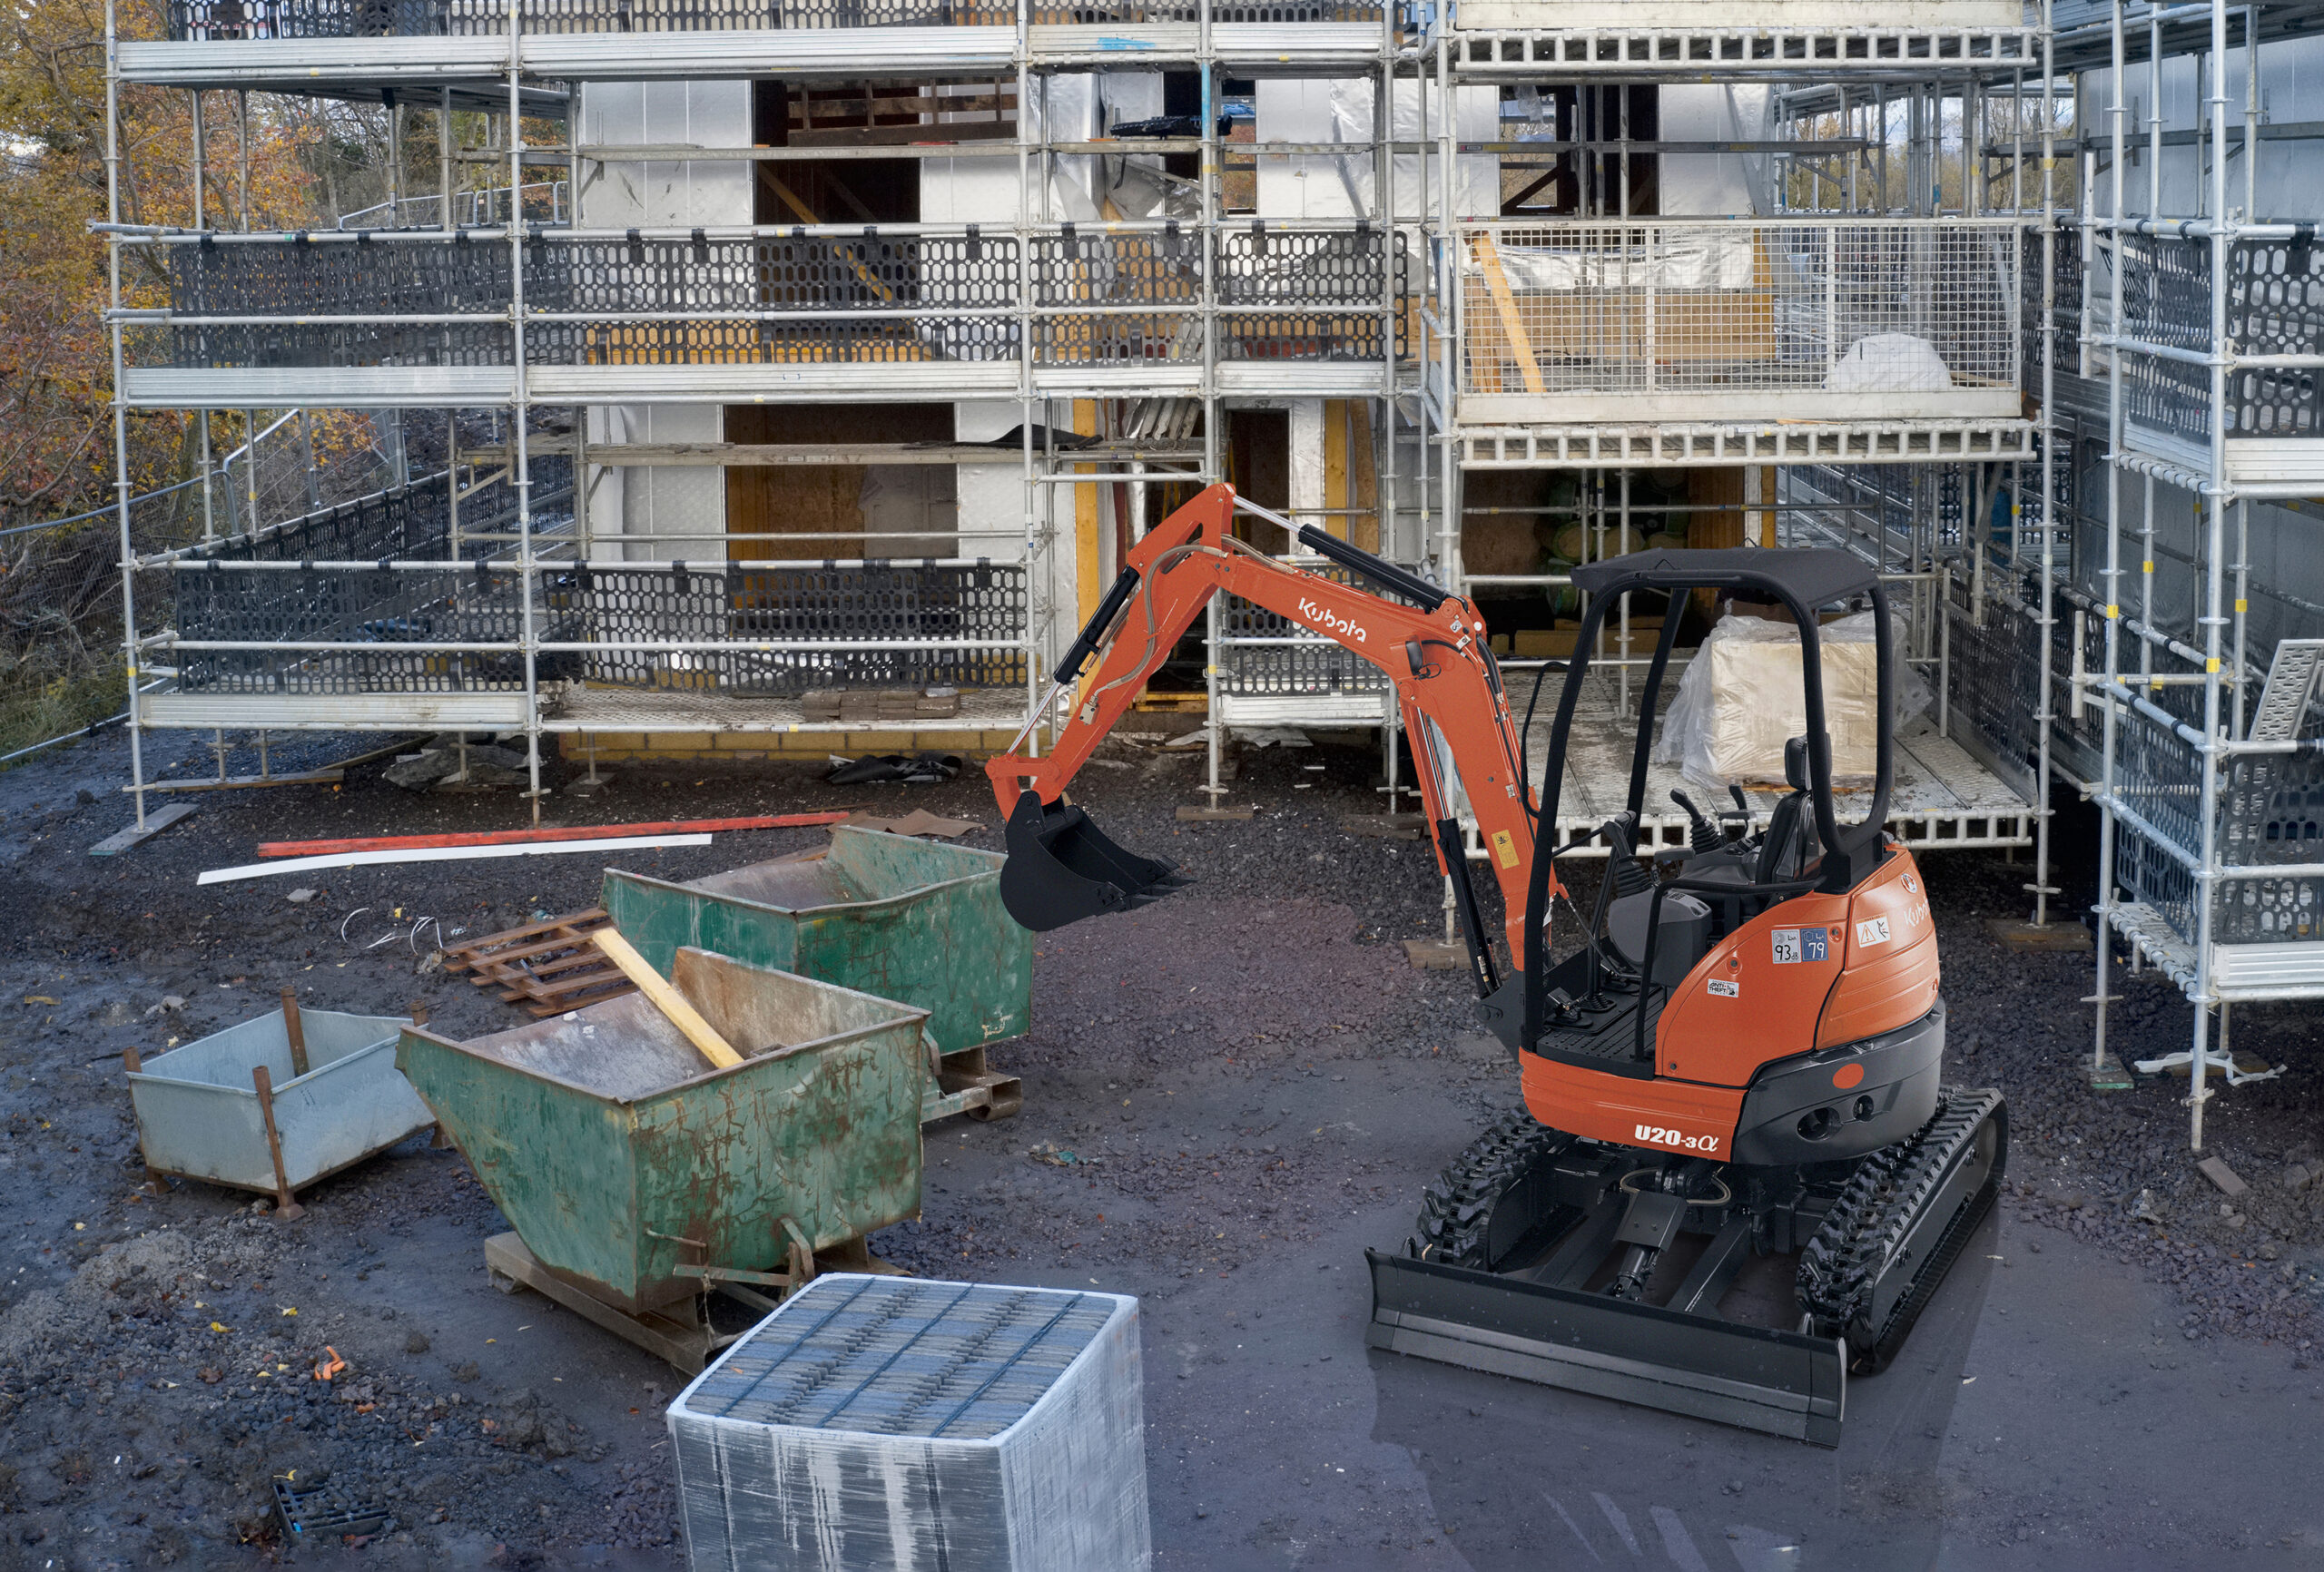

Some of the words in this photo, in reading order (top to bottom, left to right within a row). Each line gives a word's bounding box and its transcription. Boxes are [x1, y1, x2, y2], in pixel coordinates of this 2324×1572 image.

[1298, 596, 1367, 643] Kubota
[1775, 944, 1791, 961] 93
[1807, 942, 1825, 958] 79
